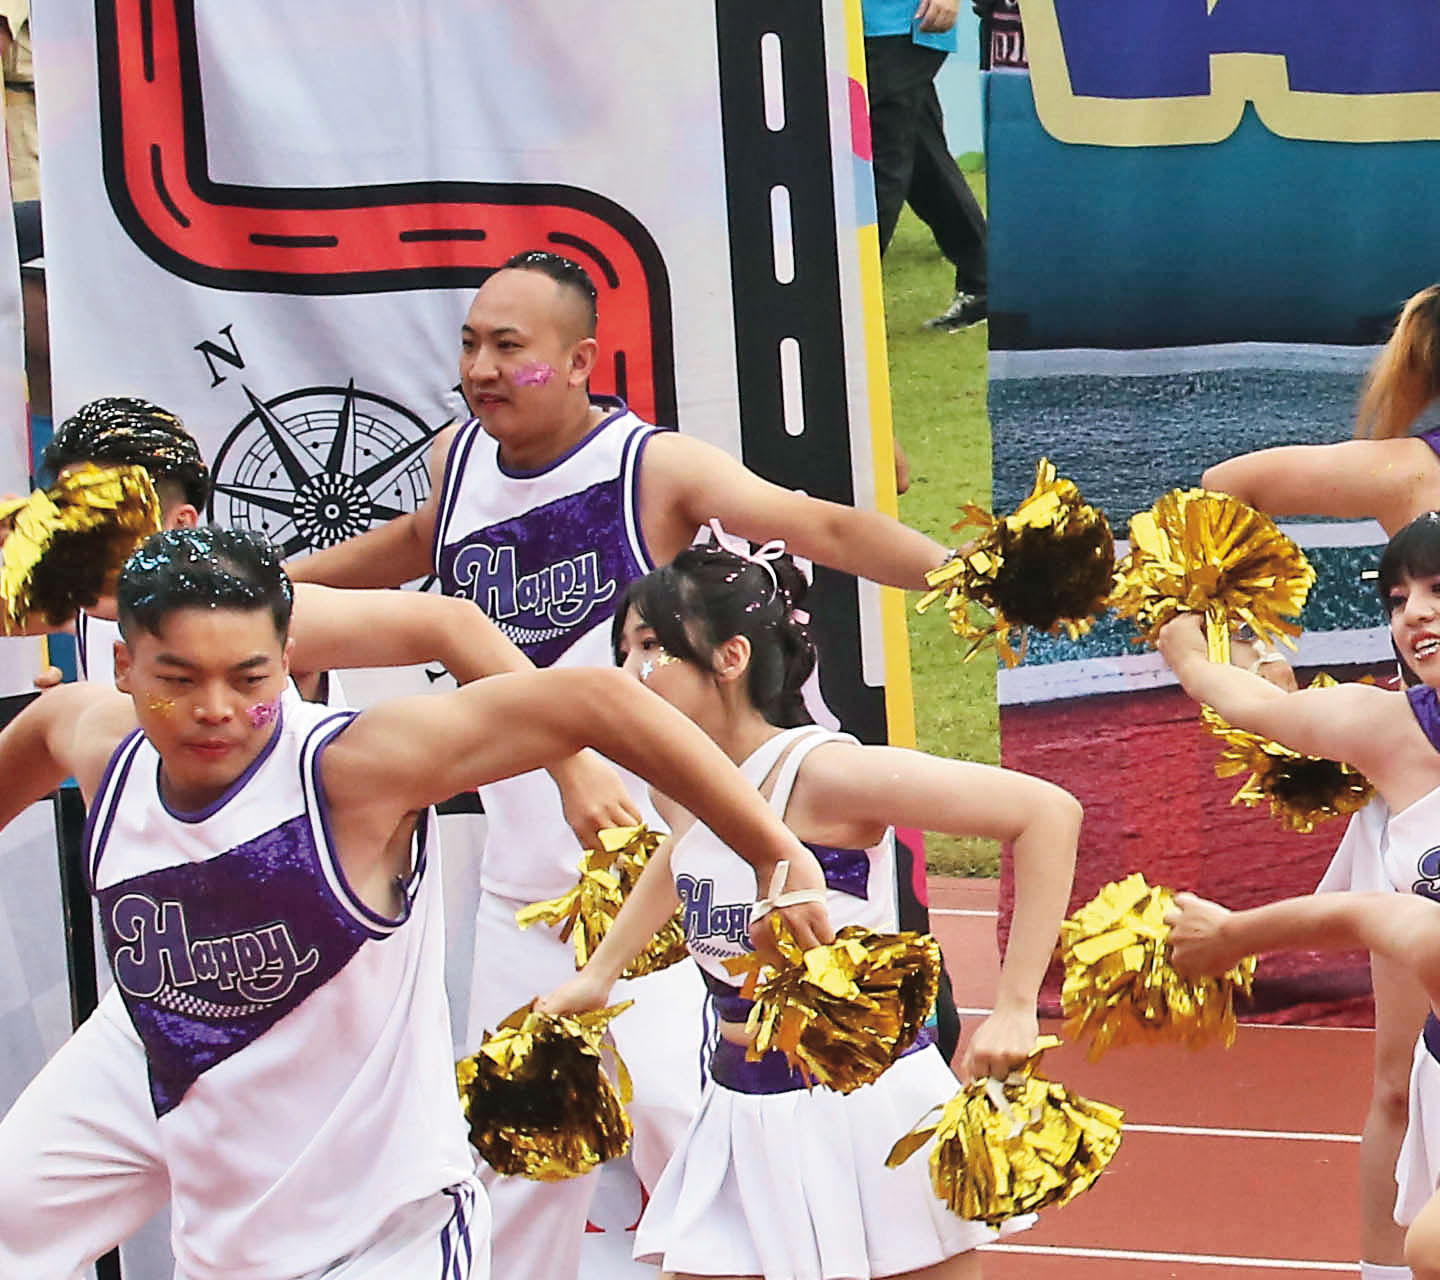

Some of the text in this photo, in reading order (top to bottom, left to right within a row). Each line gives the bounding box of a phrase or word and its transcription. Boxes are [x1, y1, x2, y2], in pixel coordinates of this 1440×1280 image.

[194, 323, 246, 388] N
[452, 543, 616, 628] Happy
[113, 893, 320, 1002] Happy
[677, 874, 757, 952] Hap
